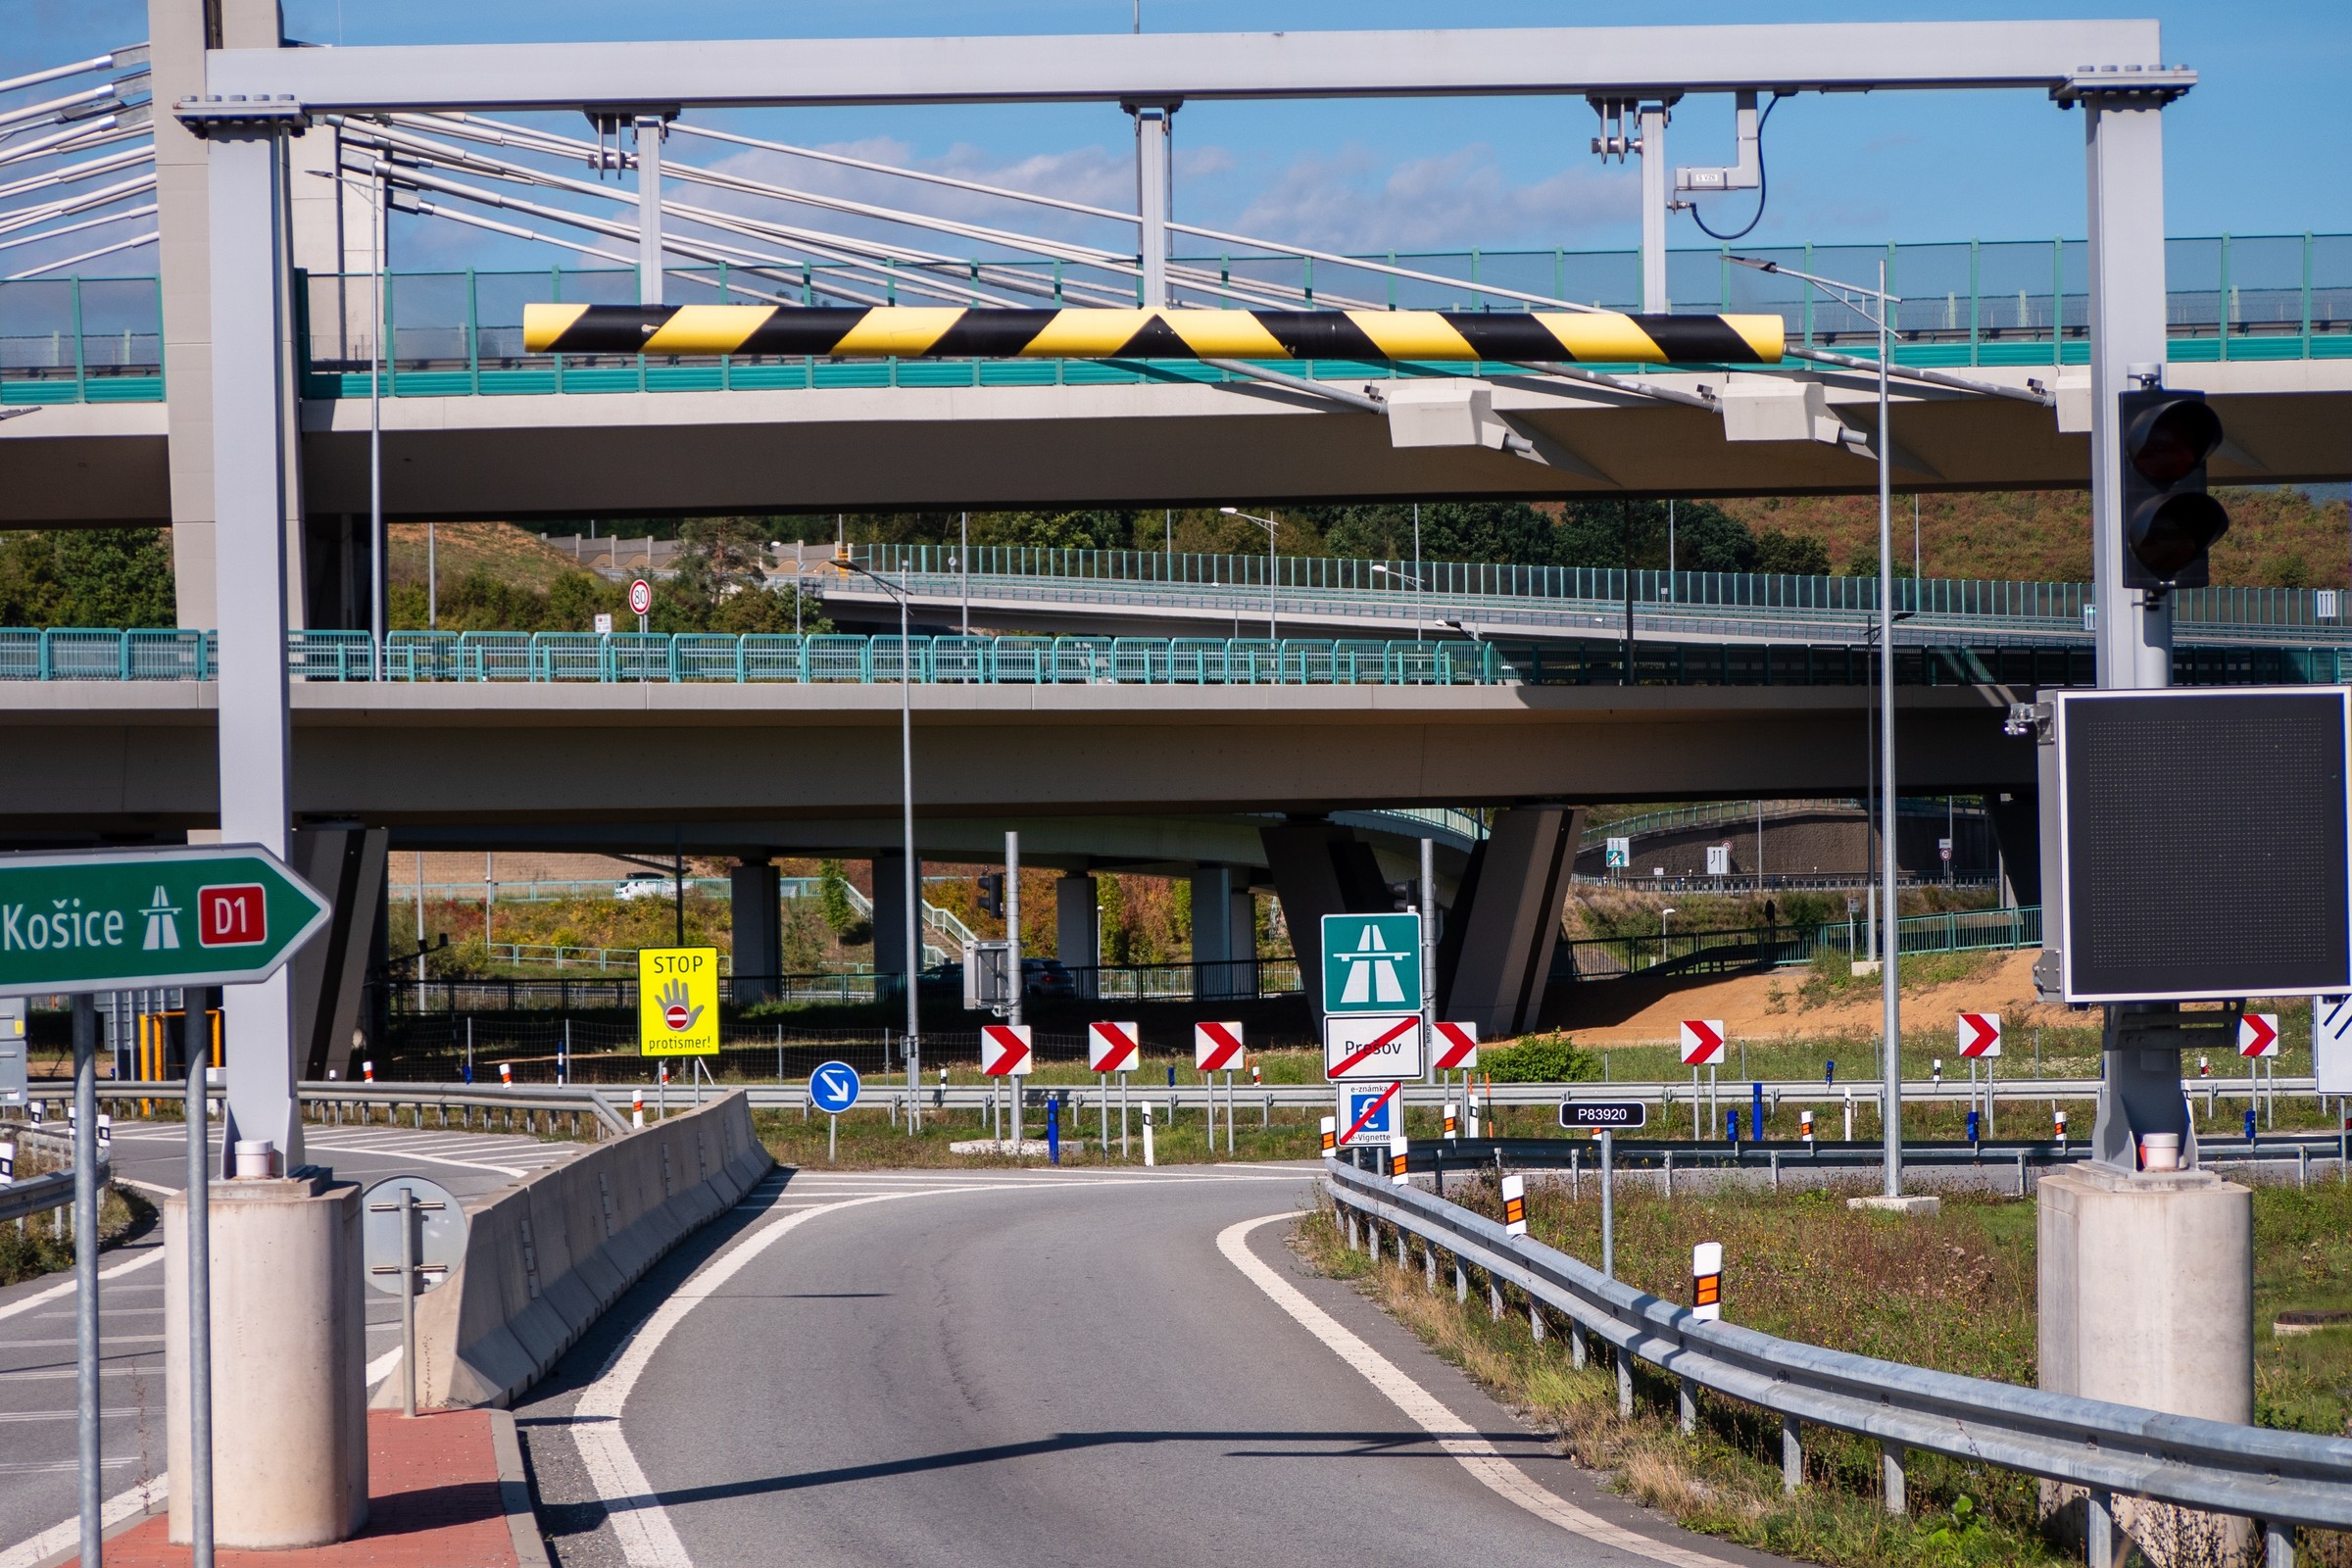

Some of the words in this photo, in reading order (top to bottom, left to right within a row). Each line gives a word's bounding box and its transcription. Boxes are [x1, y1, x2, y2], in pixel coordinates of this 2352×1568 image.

[634, 589, 647, 605] 80
[2, 898, 124, 952] Košice
[214, 896, 248, 936] D1
[654, 956, 704, 974] STOP
[649, 1035, 711, 1053] protismer!
[1345, 1039, 1402, 1056] Prešov
[1350, 1085, 1389, 1094] e-známka
[1578, 1108, 1628, 1121] P83920
[1350, 1133, 1392, 1143] e-Vignette
